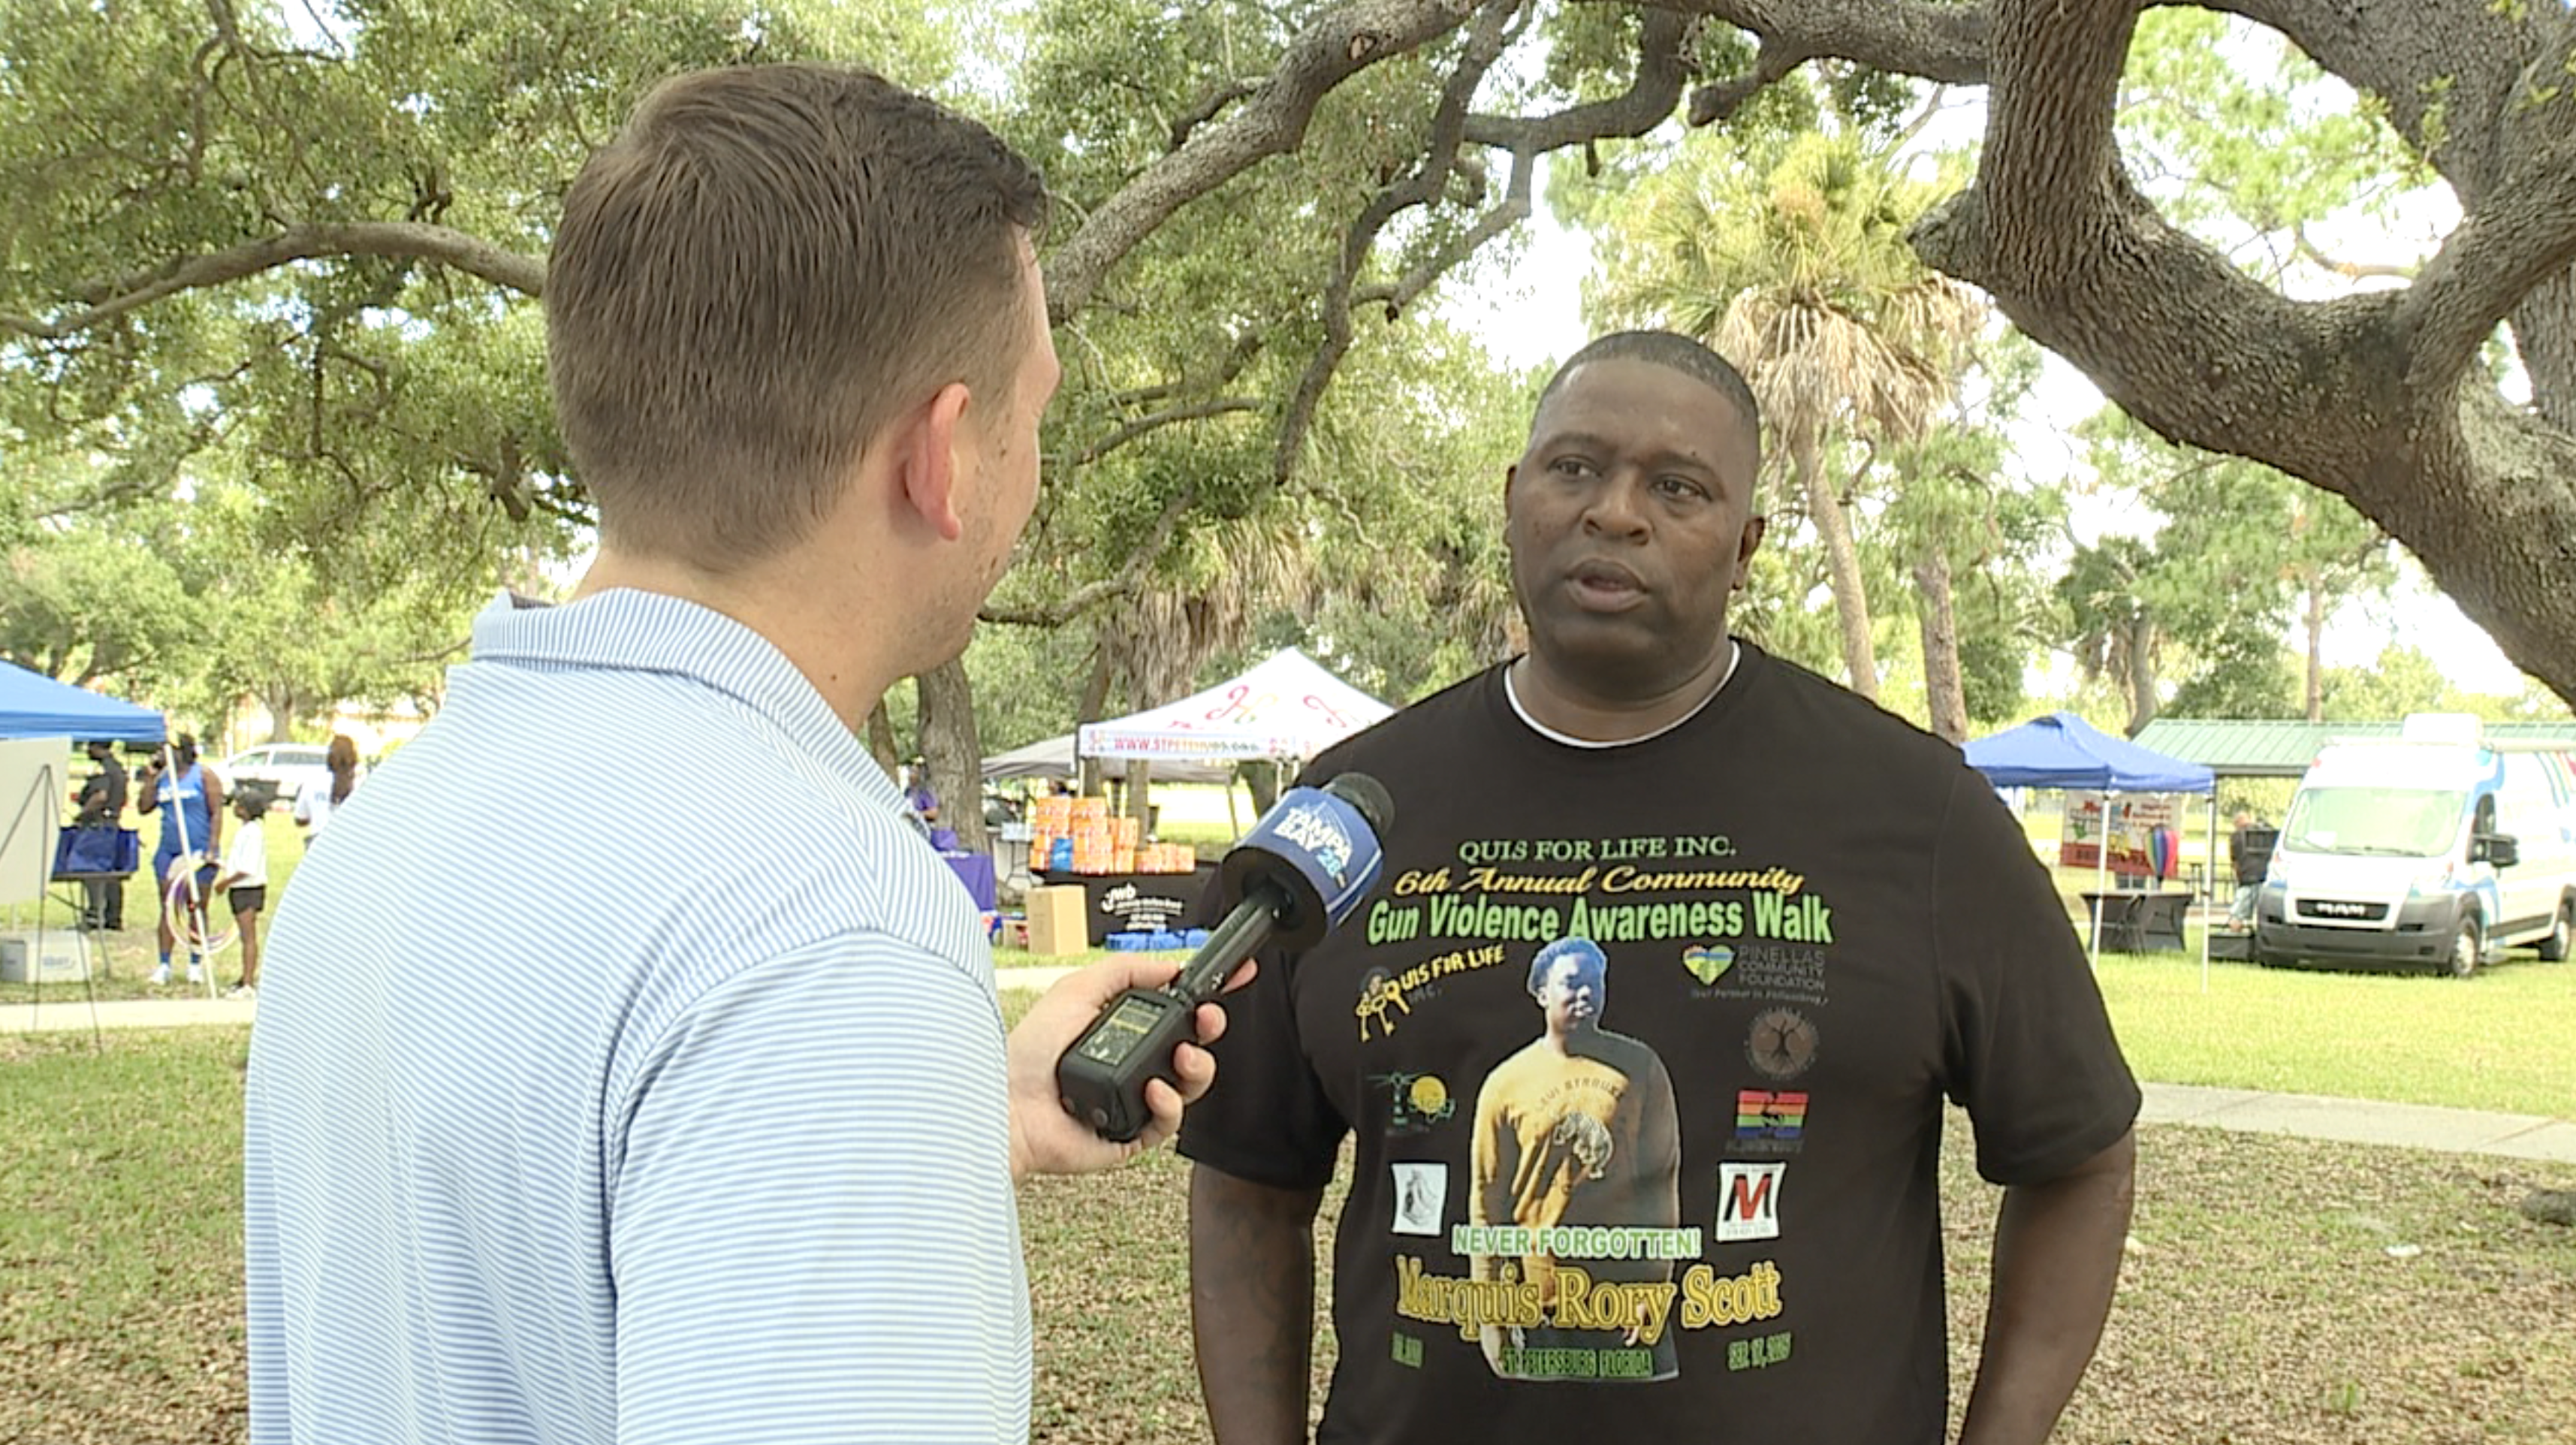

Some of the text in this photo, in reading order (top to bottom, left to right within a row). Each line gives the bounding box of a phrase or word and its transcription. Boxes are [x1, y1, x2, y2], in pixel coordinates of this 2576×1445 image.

[1273, 822, 1323, 852] BAY
[1287, 807, 1353, 868] TAMPA
[1458, 835, 1737, 864] QUIS FOR LIFE INC.
[1394, 864, 1805, 896] 6th Annual Community
[1367, 890, 1834, 946] Gun Violence Awareness Walk
[1467, 943, 1506, 969] LIFE
[1737, 944, 1825, 967] PINELLAS
[1737, 961, 1825, 979] COMMUNITY
[1738, 973, 1826, 992] FOUNDATION
[1452, 1223, 1702, 1259] NEVER FORGOTTEN!
[1395, 1253, 1783, 1346] Marquis Rory Scott
